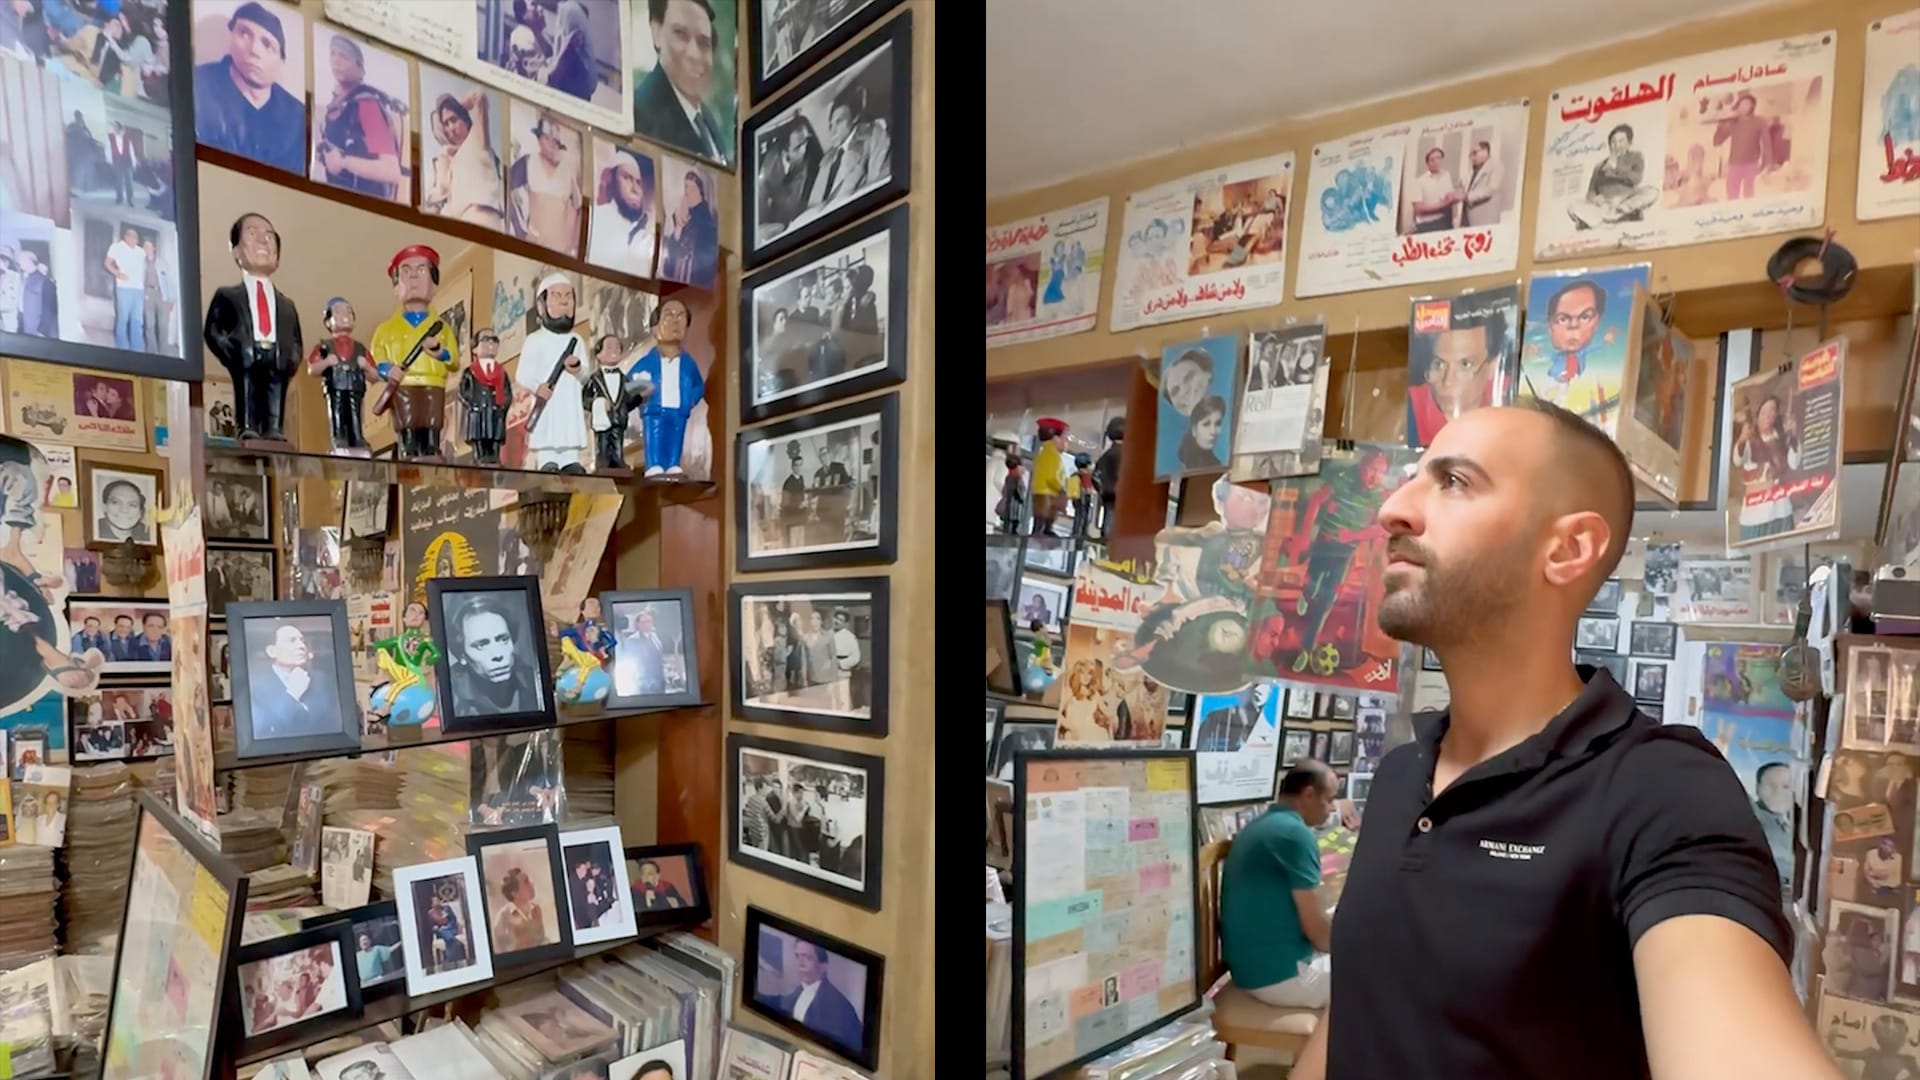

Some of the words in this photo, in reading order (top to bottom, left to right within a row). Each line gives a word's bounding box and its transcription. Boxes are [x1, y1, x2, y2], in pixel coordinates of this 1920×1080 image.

[1560, 72, 1676, 123] الهلفوت
[1392, 235, 1430, 268] الطلب
[1429, 236, 1456, 259] تحت
[1463, 230, 1493, 260] زوج
[1075, 575, 1131, 613] المدينة
